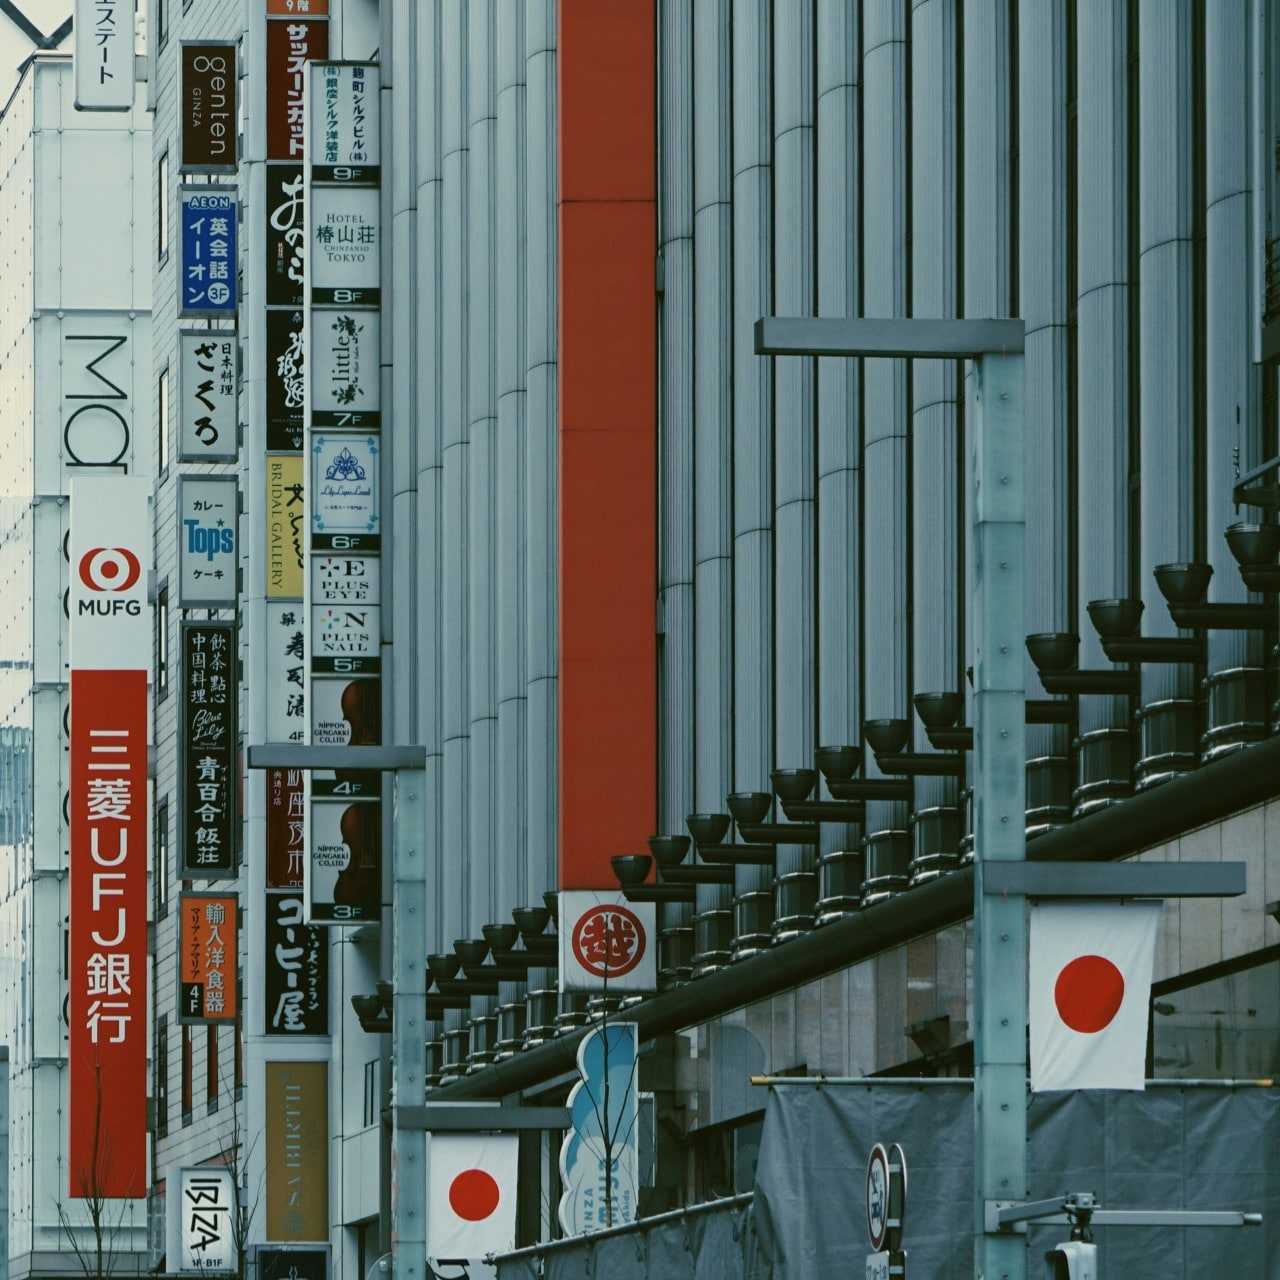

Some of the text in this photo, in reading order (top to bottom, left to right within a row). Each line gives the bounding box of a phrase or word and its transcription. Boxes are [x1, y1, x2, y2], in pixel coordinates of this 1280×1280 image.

[95, 0, 117, 85] ステート
[192, 87, 202, 128] GINZA
[194, 56, 230, 156] genten
[333, 167, 363, 181] 9F
[189, 197, 231, 210] AEON
[316, 225, 376, 244] 椿山荘
[208, 217, 229, 280] 英会話
[326, 252, 366, 262] TOKYO
[188, 217, 207, 304] イーオン
[209, 287, 228, 300] 3F
[333, 289, 362, 303] 8F
[331, 335, 350, 383] little
[219, 342, 235, 396] 日本料理
[193, 342, 219, 447] ざくろ
[332, 413, 362, 427] 7F
[193, 500, 225, 511] カレー
[271, 463, 283, 589] BRIDAL GALLERY
[331, 536, 361, 549] 6F
[193, 569, 225, 580] ケーキ
[321, 581, 370, 590] PLUS
[325, 590, 367, 600] EYE
[78, 599, 141, 617] MUFG
[321, 633, 370, 642] PLUS
[323, 643, 368, 652] NAIL
[191, 632, 207, 705] 中国料理
[333, 658, 363, 672] 5F
[192, 709, 223, 730] Blue
[332, 781, 362, 795] 4F
[194, 755, 224, 865] 青百合飯荘
[86, 729, 132, 1044] 三菱UFJ銀行
[333, 905, 362, 919] 3F
[205, 903, 226, 1014] 輸入洋食器
[272, 898, 306, 1031] コーヒー屋
[583, 1187, 594, 1229] INZA
